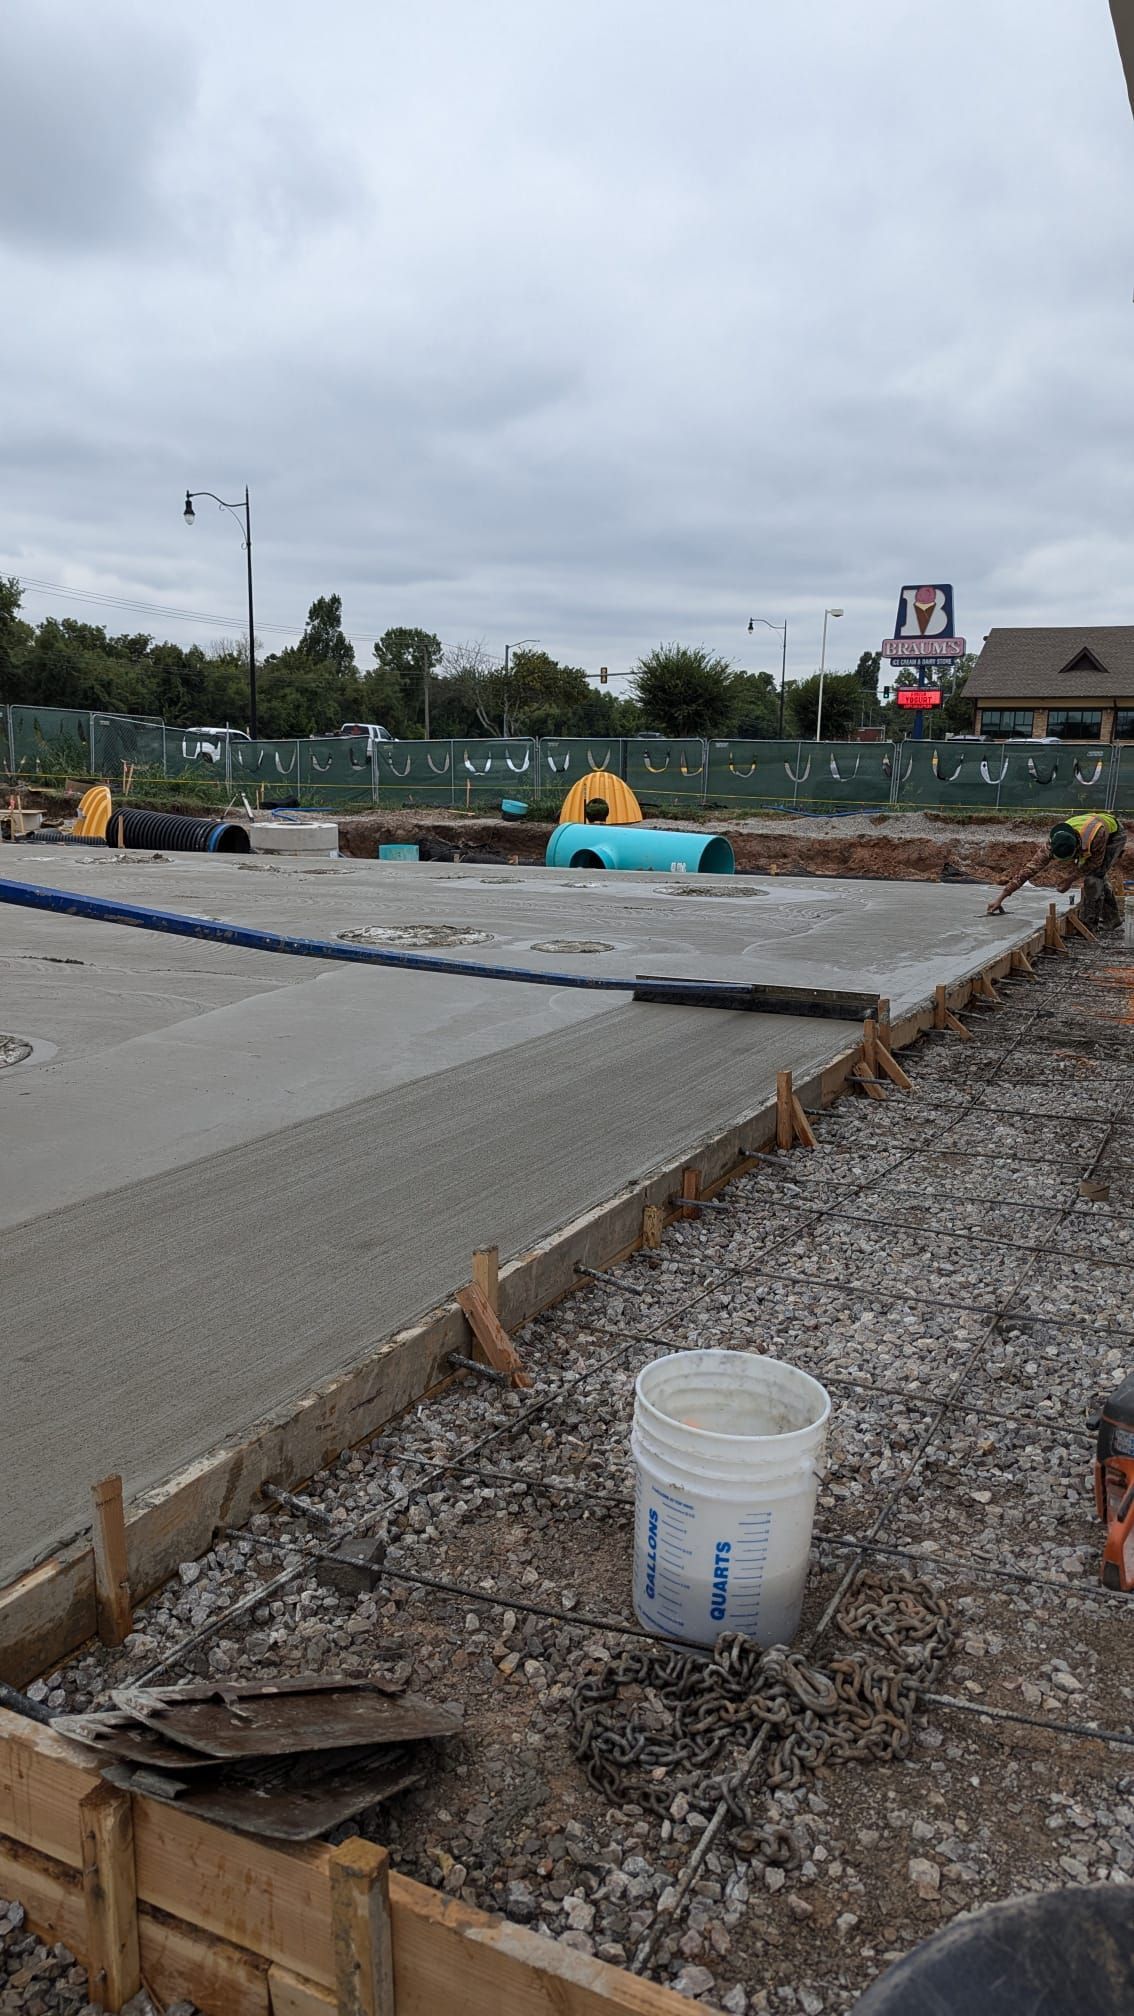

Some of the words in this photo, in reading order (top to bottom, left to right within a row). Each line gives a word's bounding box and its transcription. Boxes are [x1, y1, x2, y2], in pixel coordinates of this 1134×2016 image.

[900, 589, 948, 636] B
[886, 641, 961, 655] BRAUM'S
[646, 1508, 658, 1600] GALLONS
[710, 1541, 732, 1621] QUARTS
